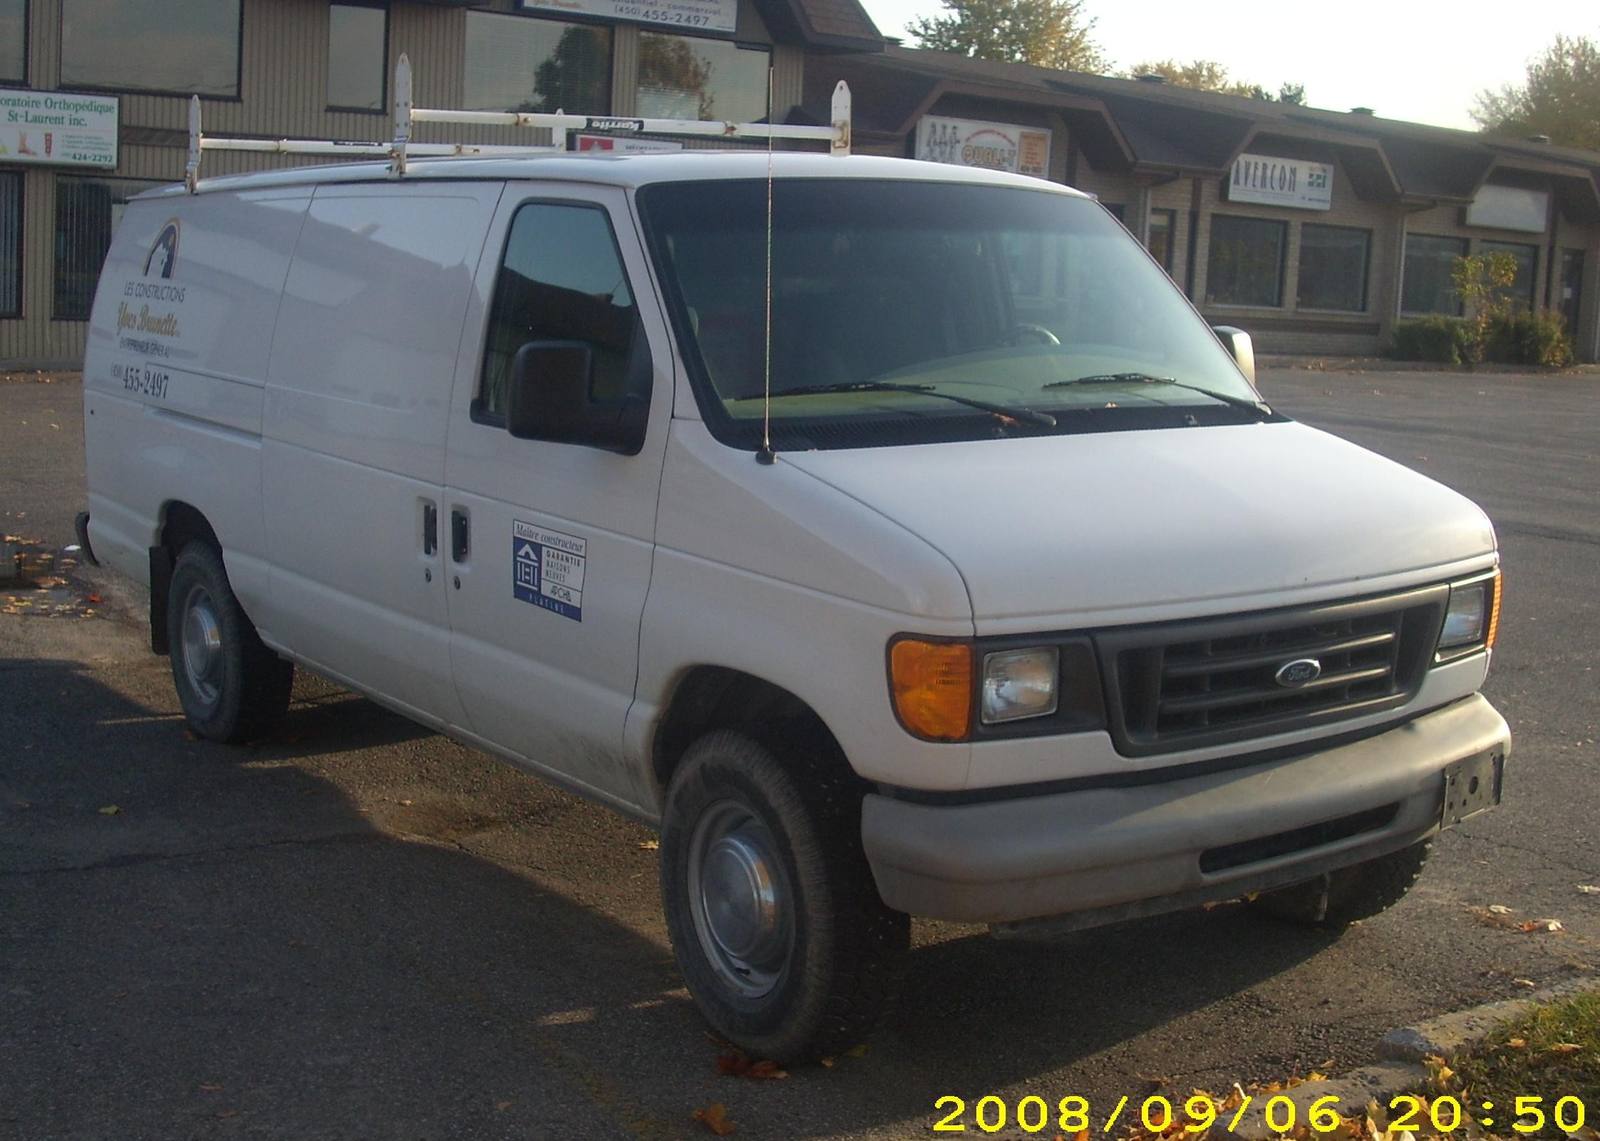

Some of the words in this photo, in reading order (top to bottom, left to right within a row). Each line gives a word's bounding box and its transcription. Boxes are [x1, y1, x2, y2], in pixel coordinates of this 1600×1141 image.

[642, 9, 709, 26] 455-2497
[44, 97, 114, 114] Orthopédique
[8, 110, 64, 125] St-Laurent
[68, 114, 87, 126] inc.
[71, 152, 112, 163] 424-2292
[124, 281, 134, 296] LES
[135, 282, 185, 303] CONSTRUCTIONS
[123, 366, 169, 400] 455-2497
[540, 533, 584, 553] constructeur
[546, 549, 581, 567] GARANTIE
